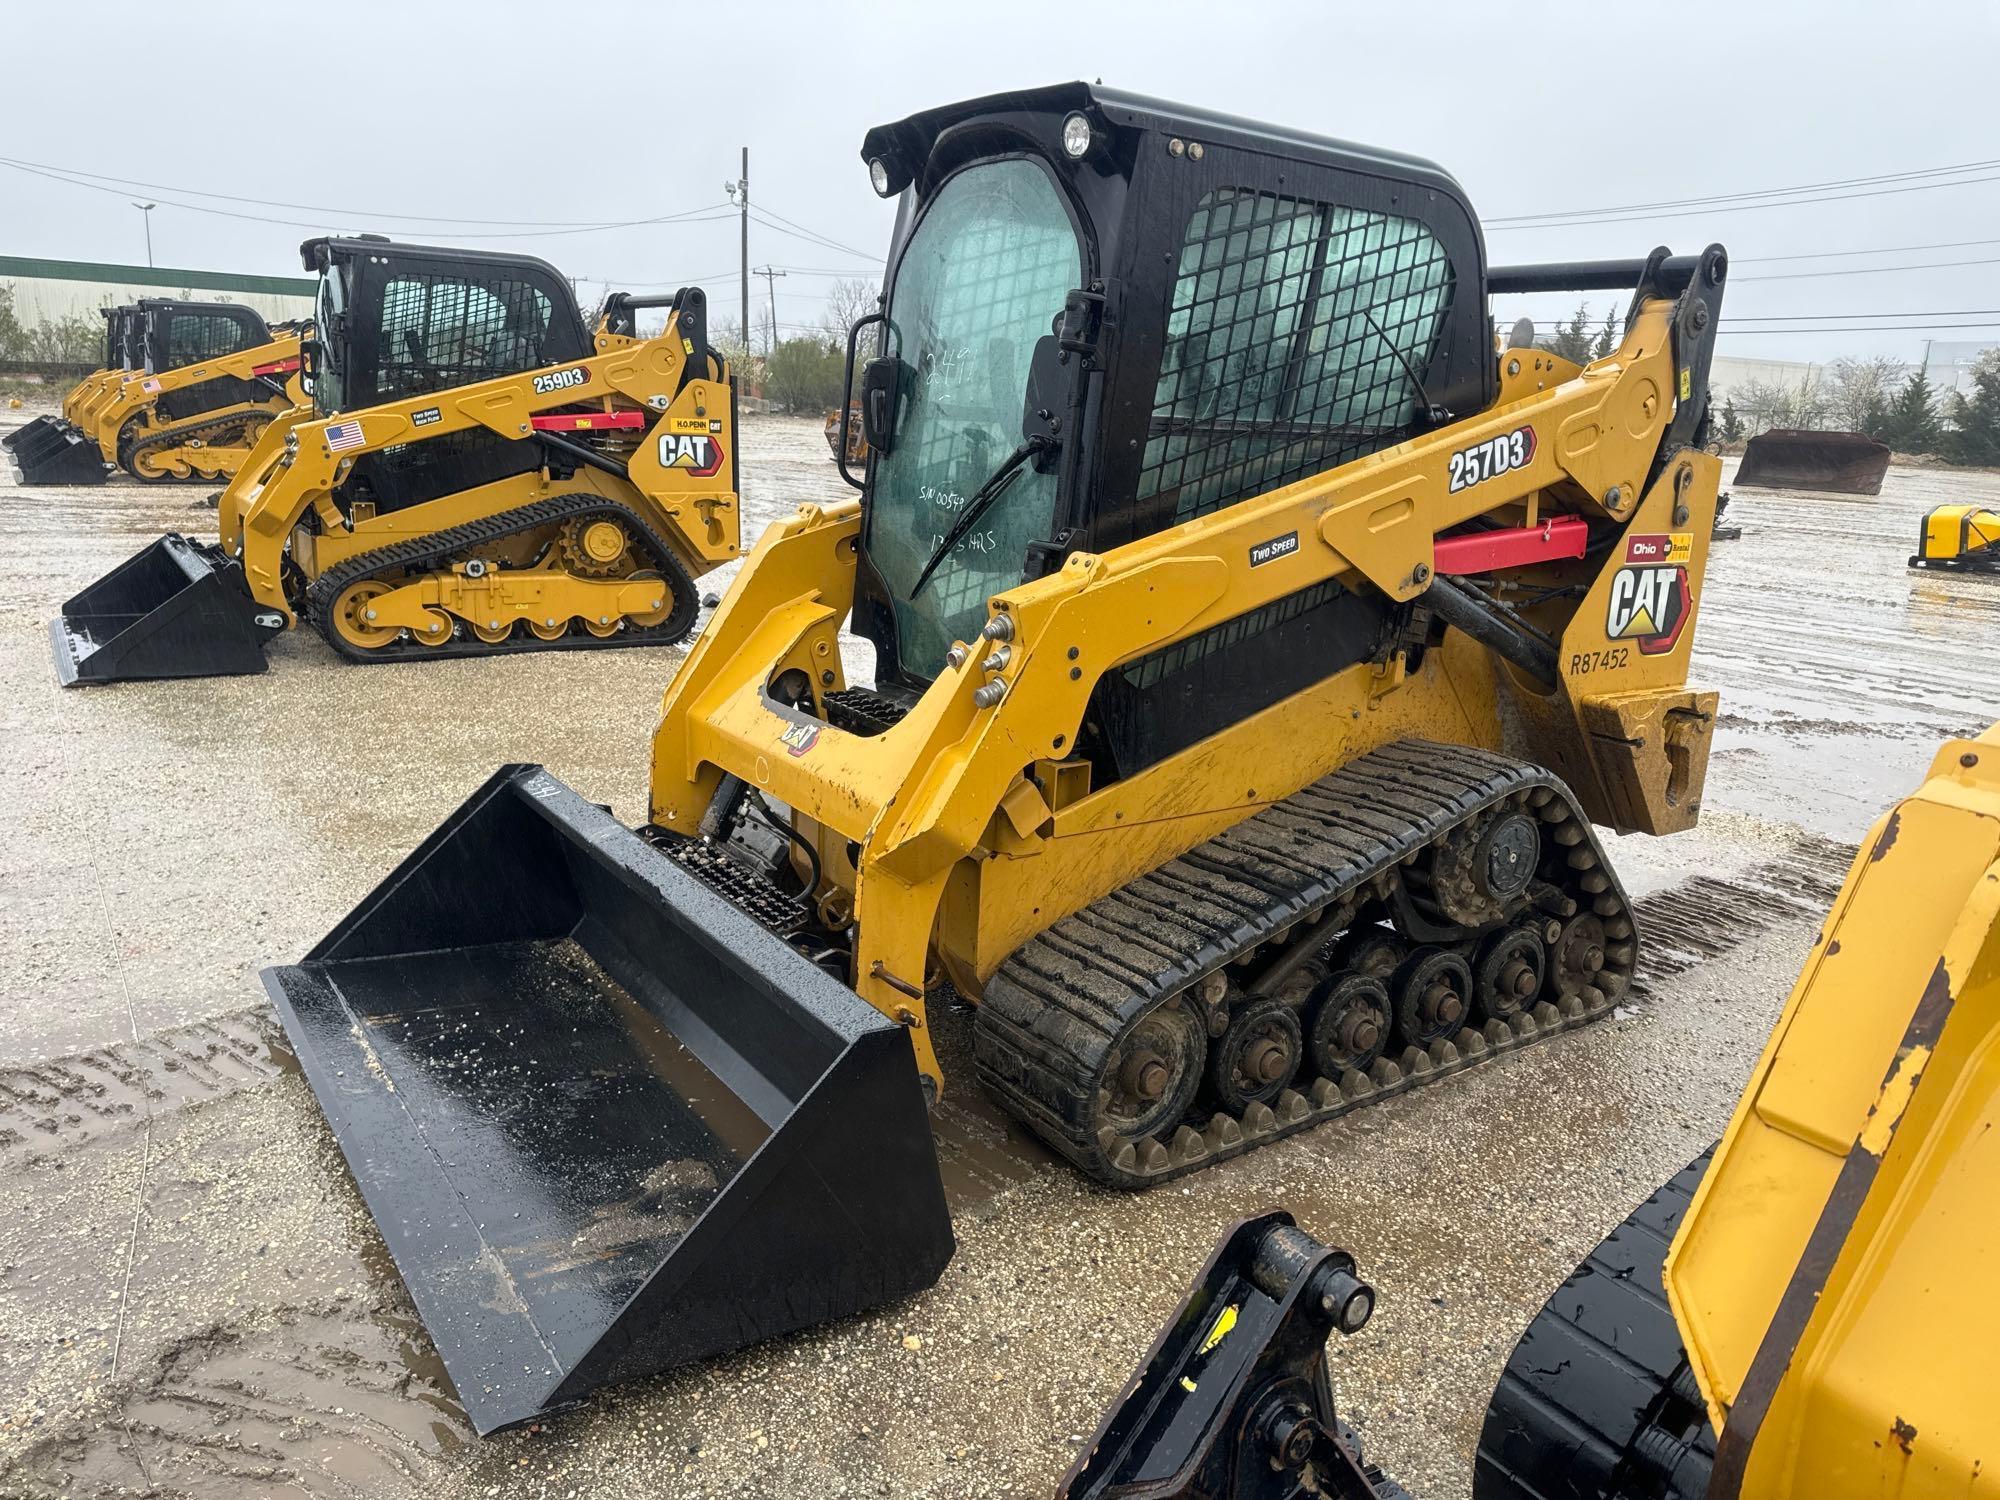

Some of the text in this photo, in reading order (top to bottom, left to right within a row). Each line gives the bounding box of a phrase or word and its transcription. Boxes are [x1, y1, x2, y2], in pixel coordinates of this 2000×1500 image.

[533, 368, 584, 395] 259D3
[709, 422, 721, 431] CAT
[659, 434, 708, 468] CAT
[1449, 430, 1524, 492] 257D3
[1252, 537, 1296, 562] TWO SPEED
[1633, 543, 1657, 555] Ohio
[1672, 543, 1690, 552] Rental
[1607, 568, 1678, 638] CAT
[1570, 647, 1629, 676] R87452
[781, 721, 819, 749] CAT
